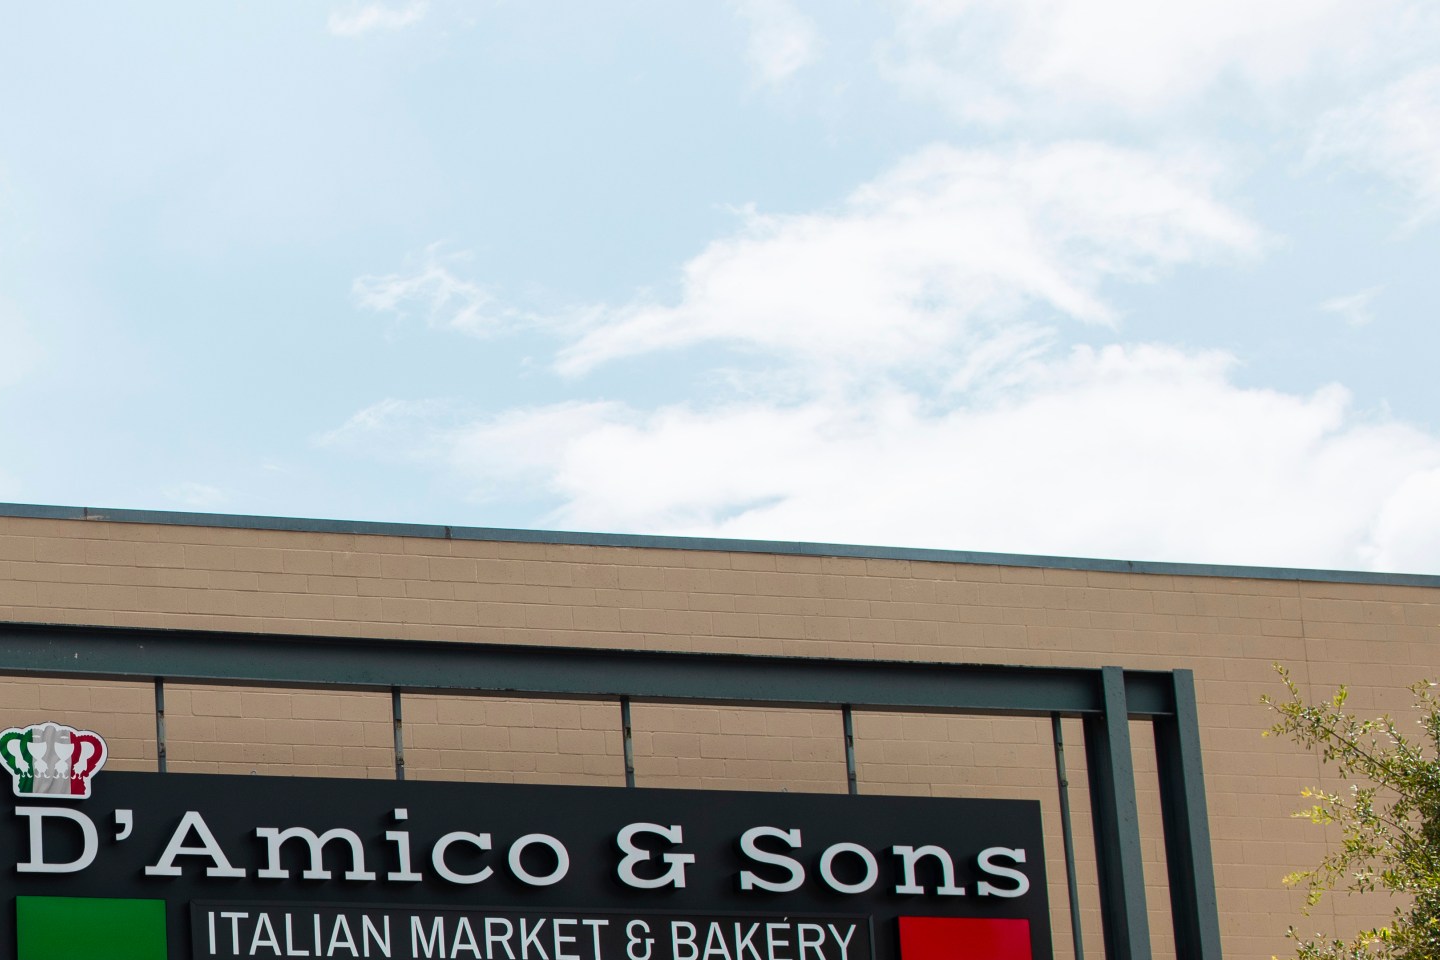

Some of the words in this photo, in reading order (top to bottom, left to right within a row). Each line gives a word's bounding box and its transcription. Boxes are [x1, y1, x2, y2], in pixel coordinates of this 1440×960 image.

[616, 822, 696, 889] &
[740, 826, 1030, 898] Sons
[208, 911, 392, 958] ITALIAN
